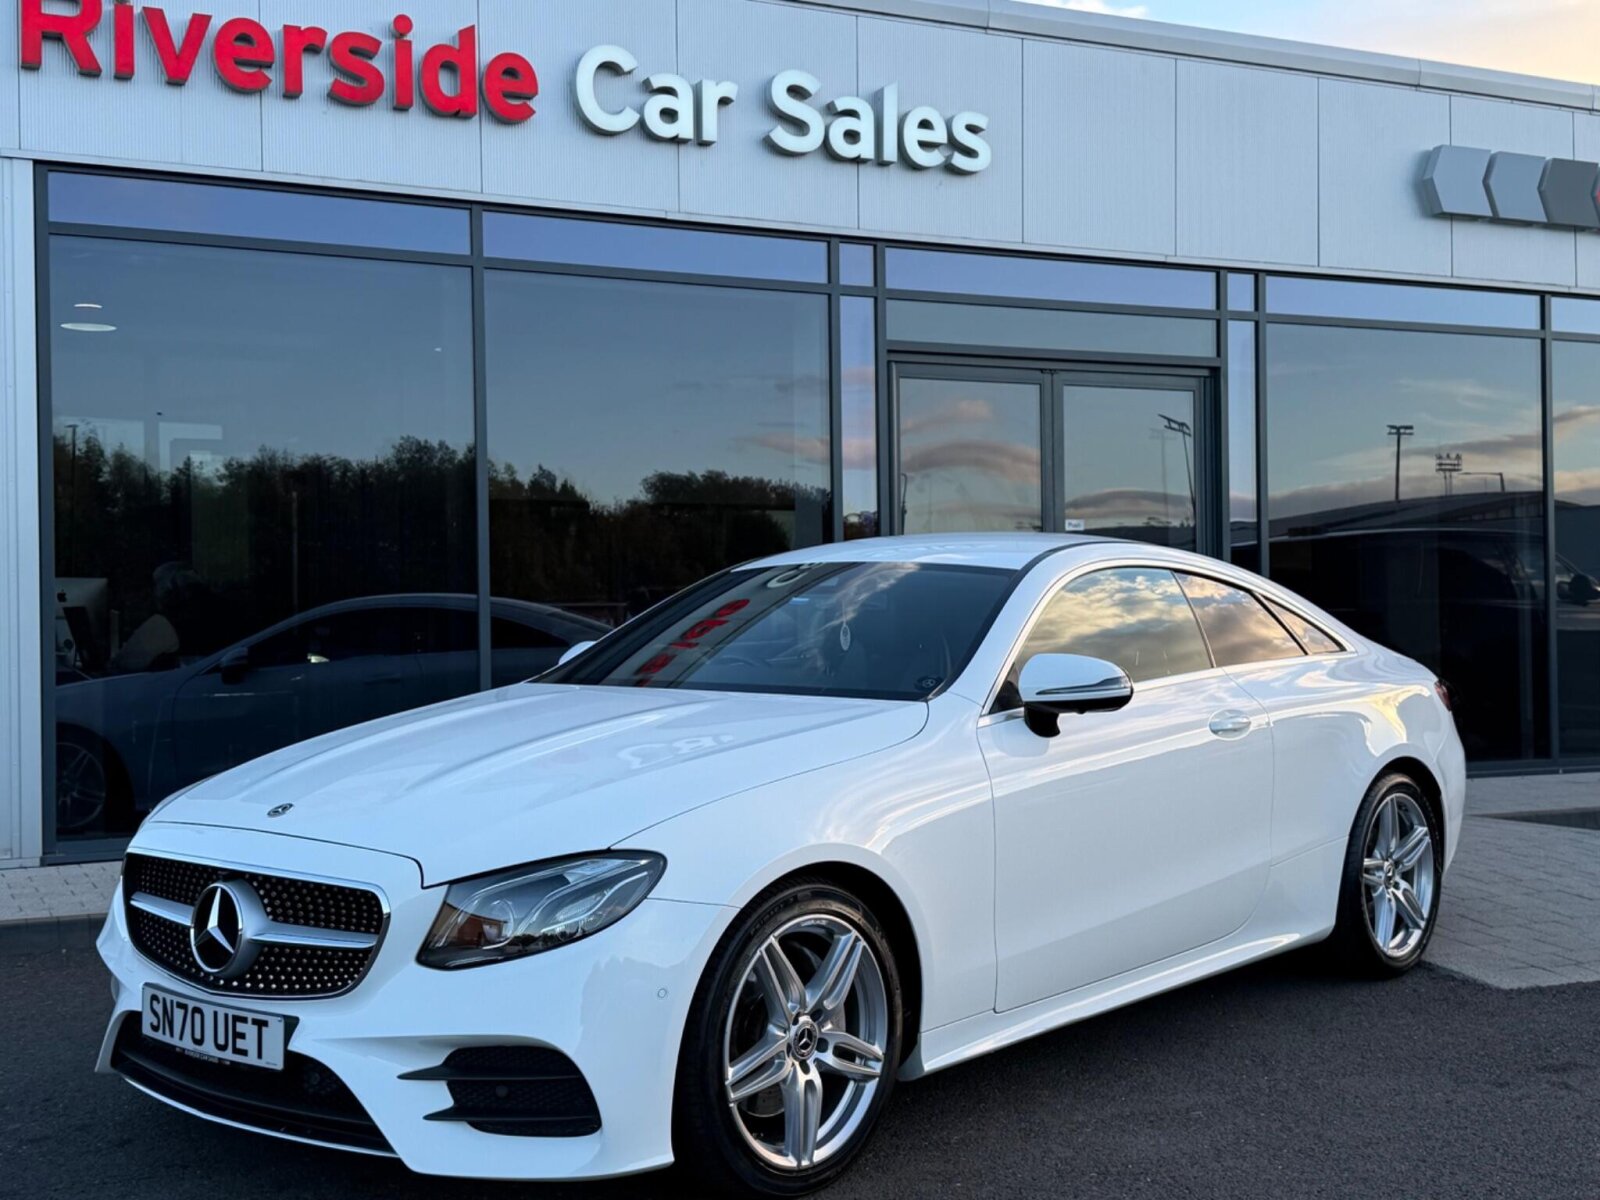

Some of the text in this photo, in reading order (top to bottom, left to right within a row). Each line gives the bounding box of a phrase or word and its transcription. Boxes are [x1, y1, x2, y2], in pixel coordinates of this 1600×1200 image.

[20, 0, 991, 174] Riverside Car Sales
[150, 994, 269, 1060] SN70 UET
